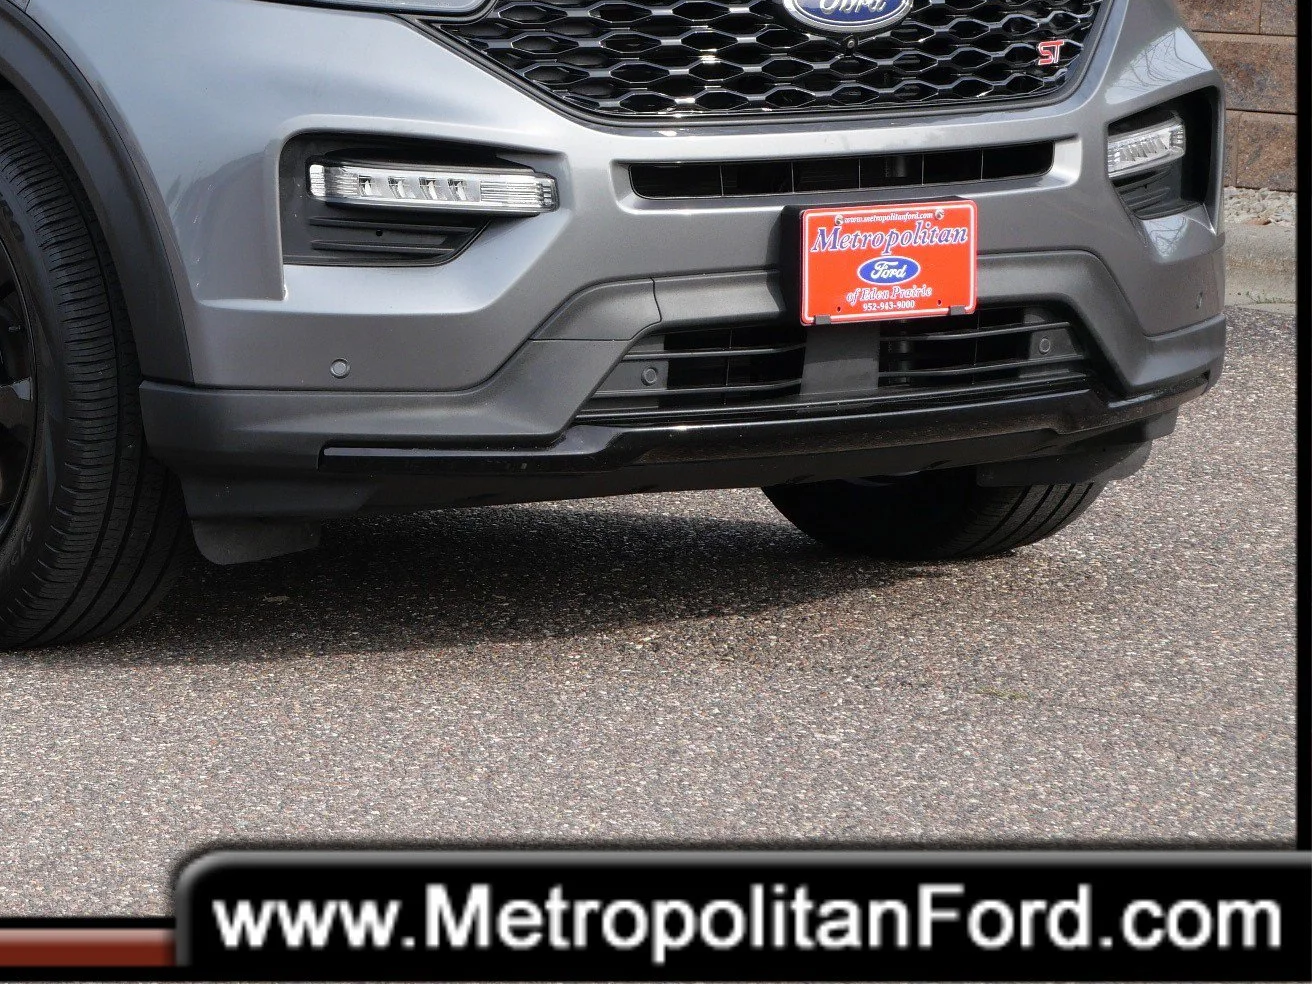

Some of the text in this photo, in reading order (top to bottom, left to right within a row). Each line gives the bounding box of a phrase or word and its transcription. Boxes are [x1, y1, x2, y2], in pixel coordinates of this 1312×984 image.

[1038, 39, 1065, 65] ST
[843, 211, 934, 224] www.metropolitanford.com
[810, 220, 969, 256] Metropolitan
[870, 260, 908, 280] Ford
[846, 284, 933, 307] of Eden Prairie
